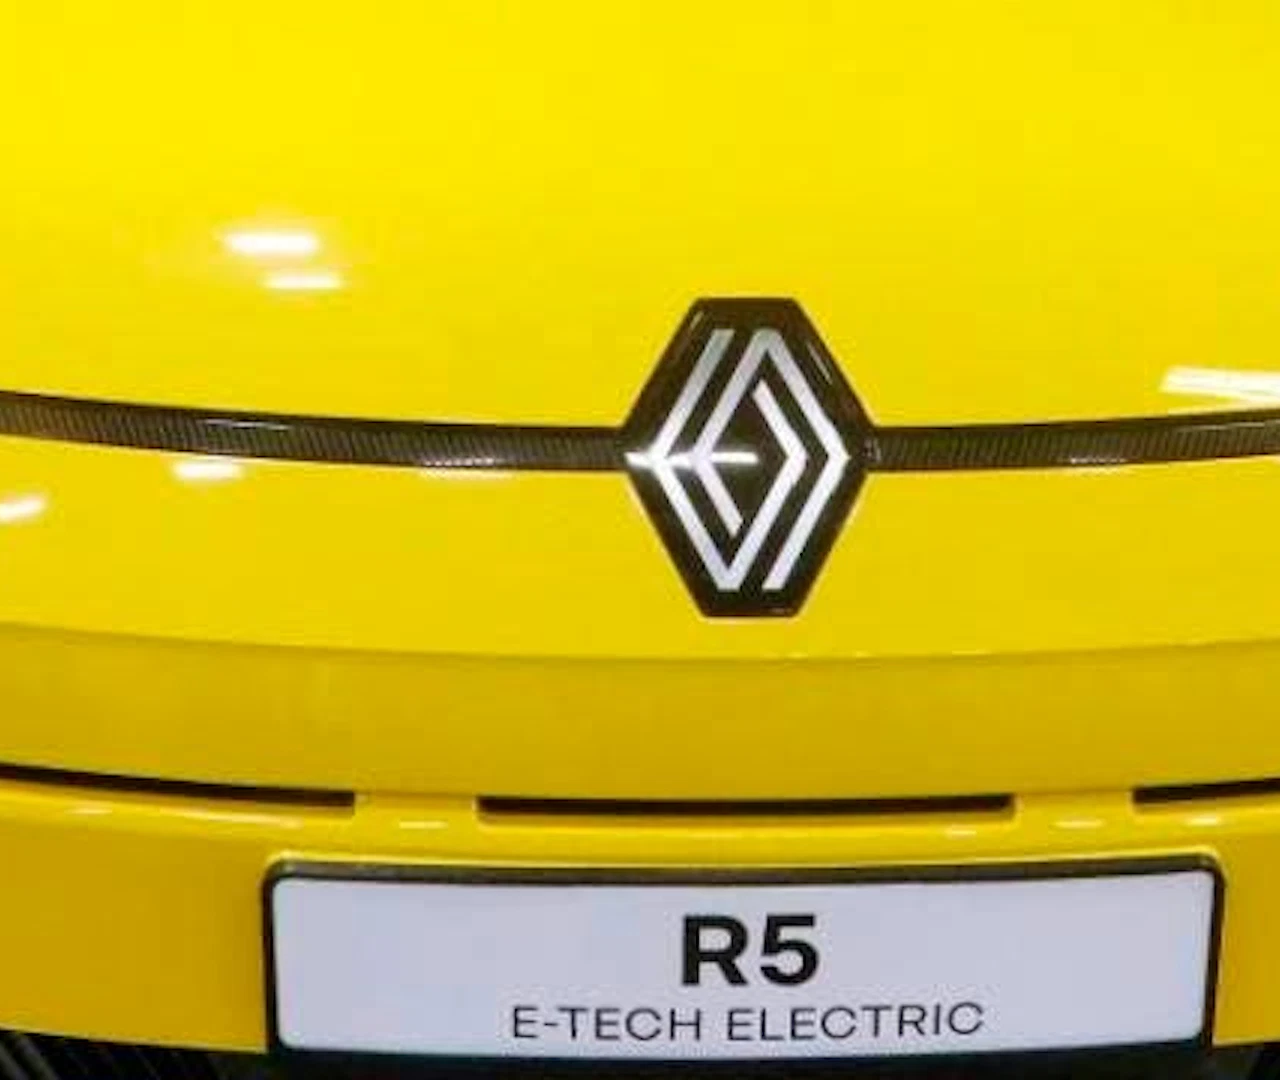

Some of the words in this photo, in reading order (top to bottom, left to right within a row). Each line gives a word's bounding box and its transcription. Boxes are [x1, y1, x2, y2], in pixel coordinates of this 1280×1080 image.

[681, 914, 820, 987] R5
[512, 1006, 703, 1042] E-TECH
[727, 1001, 986, 1042] ELECTRIC
